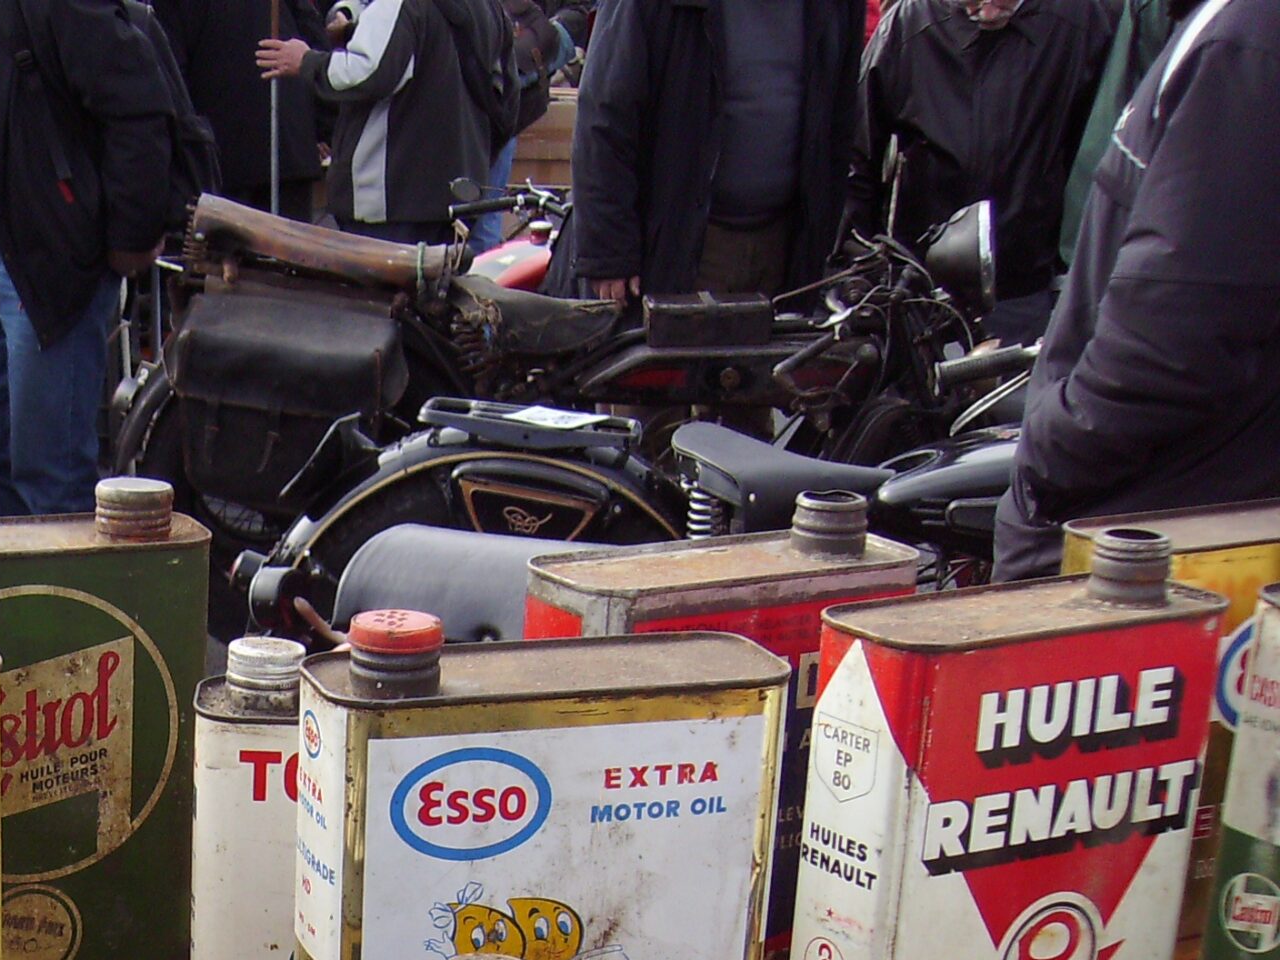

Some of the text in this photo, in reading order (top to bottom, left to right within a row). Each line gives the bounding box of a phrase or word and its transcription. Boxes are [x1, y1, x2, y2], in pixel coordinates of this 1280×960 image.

[0, 651, 120, 780] strol
[976, 666, 1176, 752] HUILE
[824, 724, 871, 753] CARTER
[20, 748, 107, 783] HUILE POUR
[604, 761, 719, 789] EXTRA
[835, 750, 853, 768] EP
[31, 764, 99, 794] MOTEURS
[832, 771, 851, 790] 80
[590, 796, 727, 824] MOTOR OIL
[922, 759, 1197, 861] RENAULT
[810, 822, 868, 862] HUILES
[801, 842, 877, 890] RENAULT
